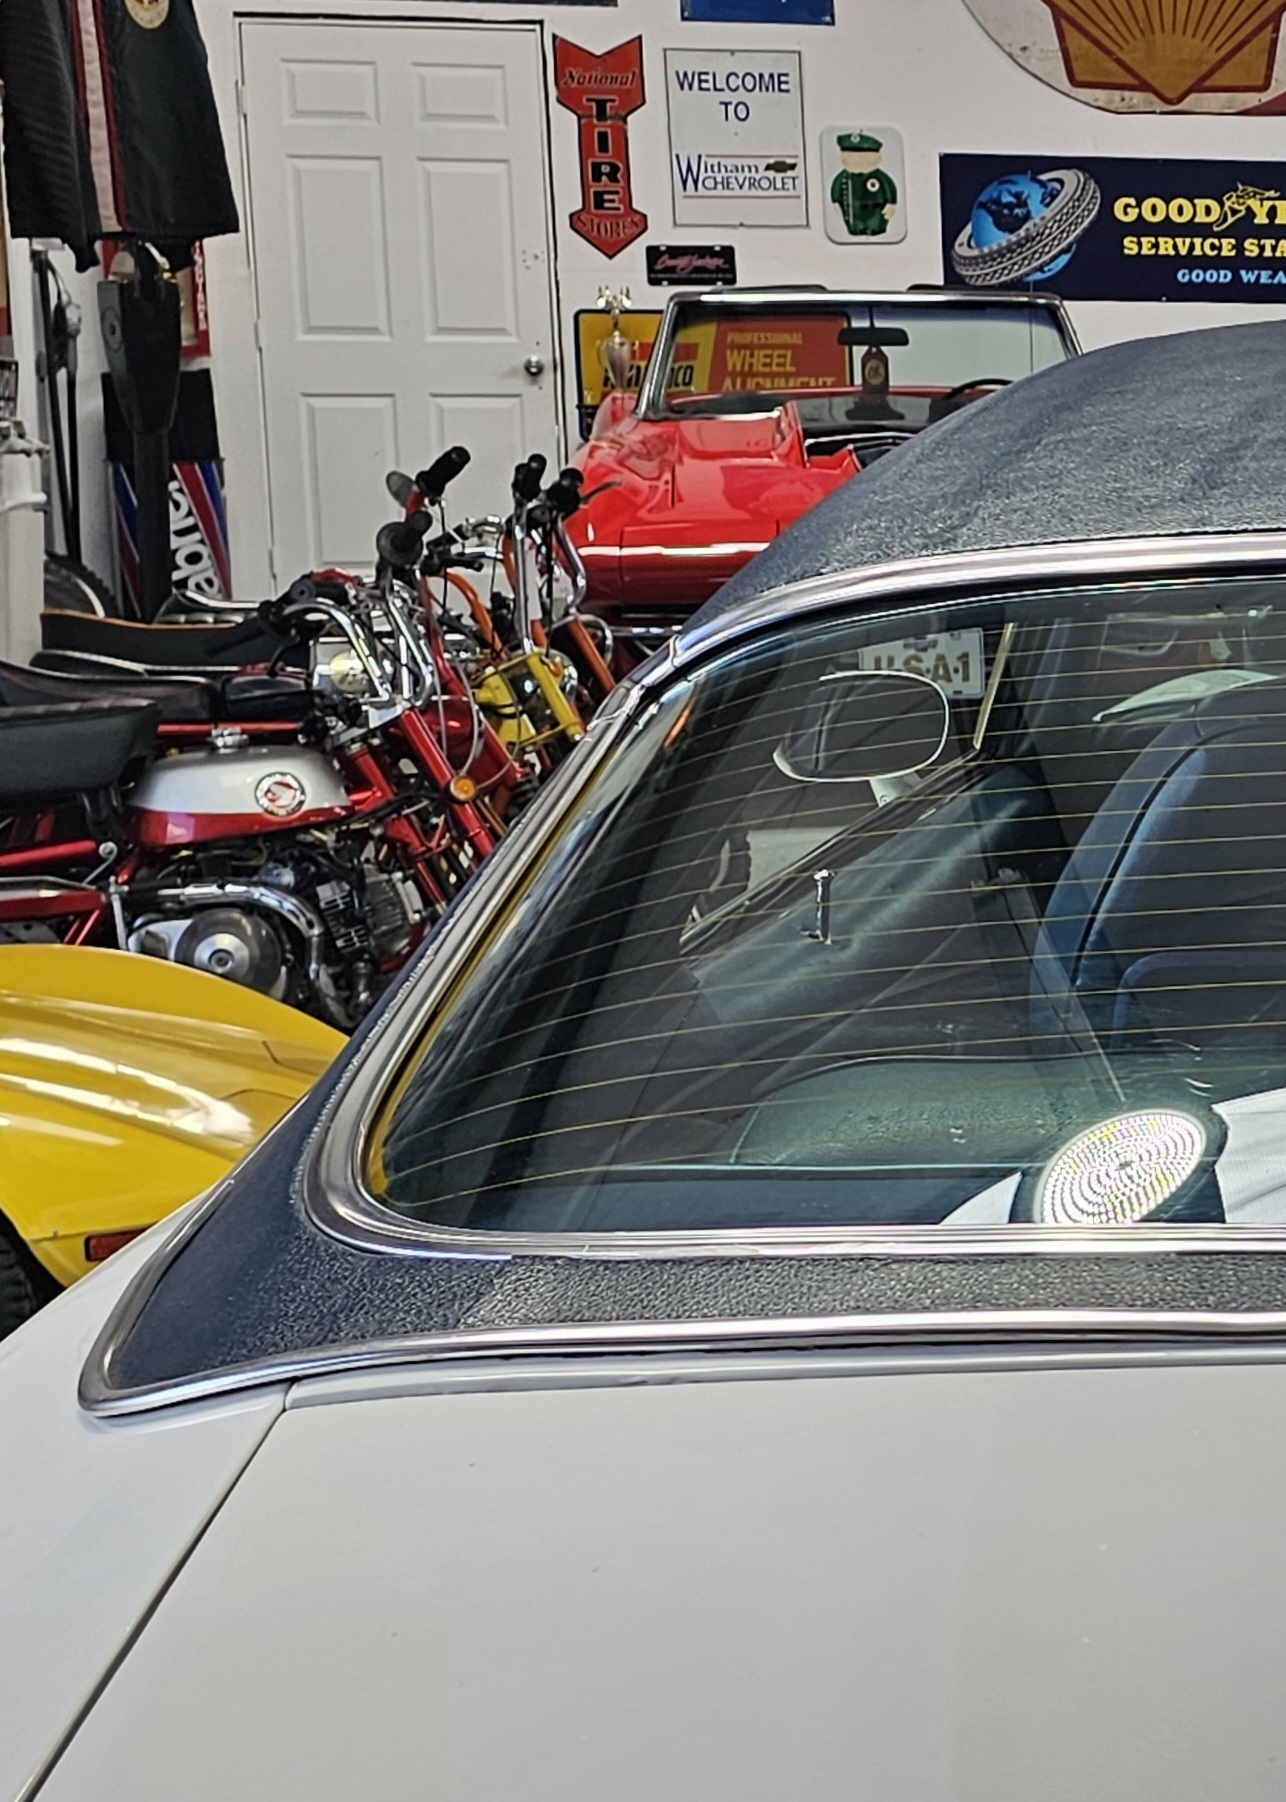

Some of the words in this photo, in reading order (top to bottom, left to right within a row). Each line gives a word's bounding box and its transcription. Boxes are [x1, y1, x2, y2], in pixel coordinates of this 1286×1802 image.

[563, 67, 637, 88] National
[675, 70, 791, 93] WELCOME
[719, 101, 750, 122] TO
[582, 96, 624, 212] TIRE
[675, 153, 760, 193] Witham
[701, 175, 800, 192] CHEVROLET
[1123, 236, 1237, 257] SERVICE
[1177, 268, 1232, 284] GOOD
[727, 331, 803, 345] PROFESSIONAL
[726, 350, 796, 372] WHEEL
